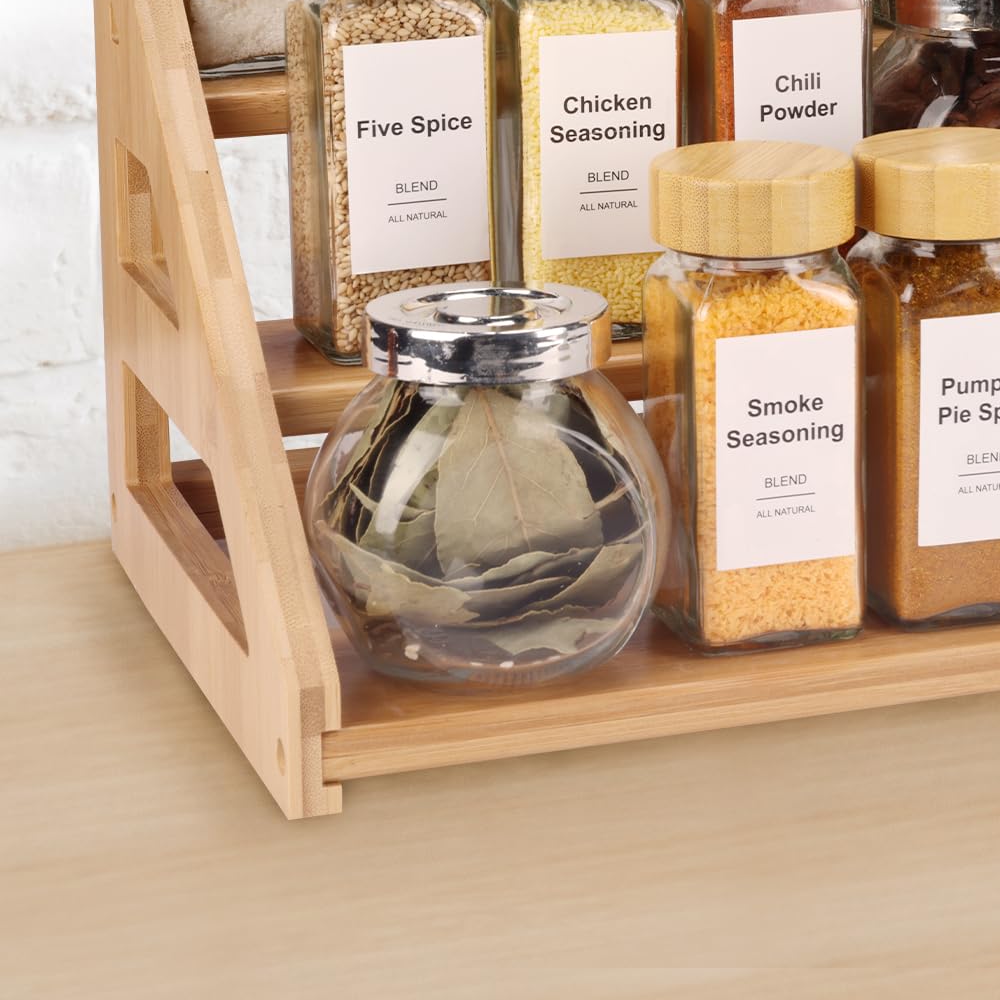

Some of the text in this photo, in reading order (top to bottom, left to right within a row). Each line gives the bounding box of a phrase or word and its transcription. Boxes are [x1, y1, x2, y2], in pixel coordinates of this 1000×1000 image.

[775, 71, 821, 94] Chili
[563, 93, 652, 115] Chicken
[759, 99, 839, 123] Powder
[356, 113, 473, 140] Five Spice
[549, 120, 666, 144] Seasoning
[395, 179, 439, 195] BLEND
[587, 169, 630, 184] BLEND
[387, 209, 449, 224] ALL NATURAL
[579, 200, 639, 212] ALL NATURAL
[747, 393, 824, 418] Smoke
[938, 405, 972, 426] Pie
[726, 421, 844, 449] Seasoning
[764, 473, 808, 489] BLEND
[956, 484, 974, 496] ALL
[755, 504, 816, 519] ALL NATURAL
